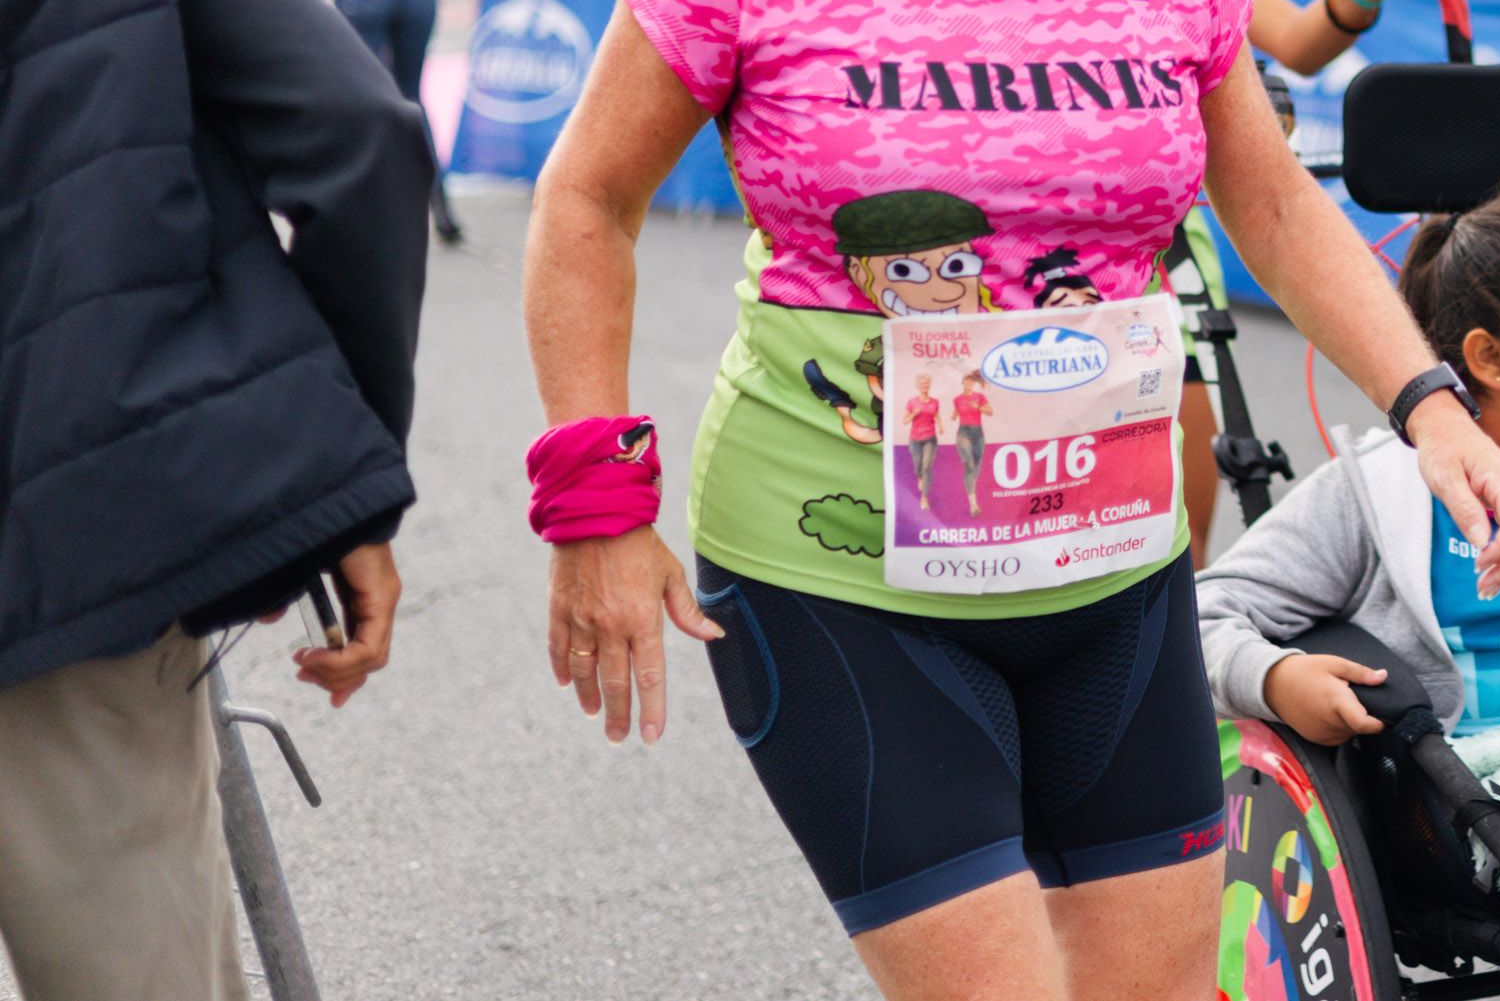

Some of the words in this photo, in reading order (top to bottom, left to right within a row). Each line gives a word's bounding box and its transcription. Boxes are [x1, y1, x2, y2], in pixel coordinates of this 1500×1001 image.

[841, 58, 1184, 113] MARINES
[908, 332, 923, 341] TU
[925, 331, 972, 342] DORSAL
[912, 342, 973, 359] SUMA
[993, 353, 1103, 379] ASTURIANA
[992, 434, 1096, 489] 016
[1029, 492, 1065, 515] 233
[919, 526, 989, 544] CARRERA
[992, 523, 1013, 541] DE
[1014, 521, 1032, 539] LA
[1033, 514, 1077, 535] MUJER
[1087, 508, 1097, 524] A
[1101, 498, 1151, 523] CORUÑA
[1073, 535, 1147, 564] Santander
[924, 556, 1021, 578] OYSHO
